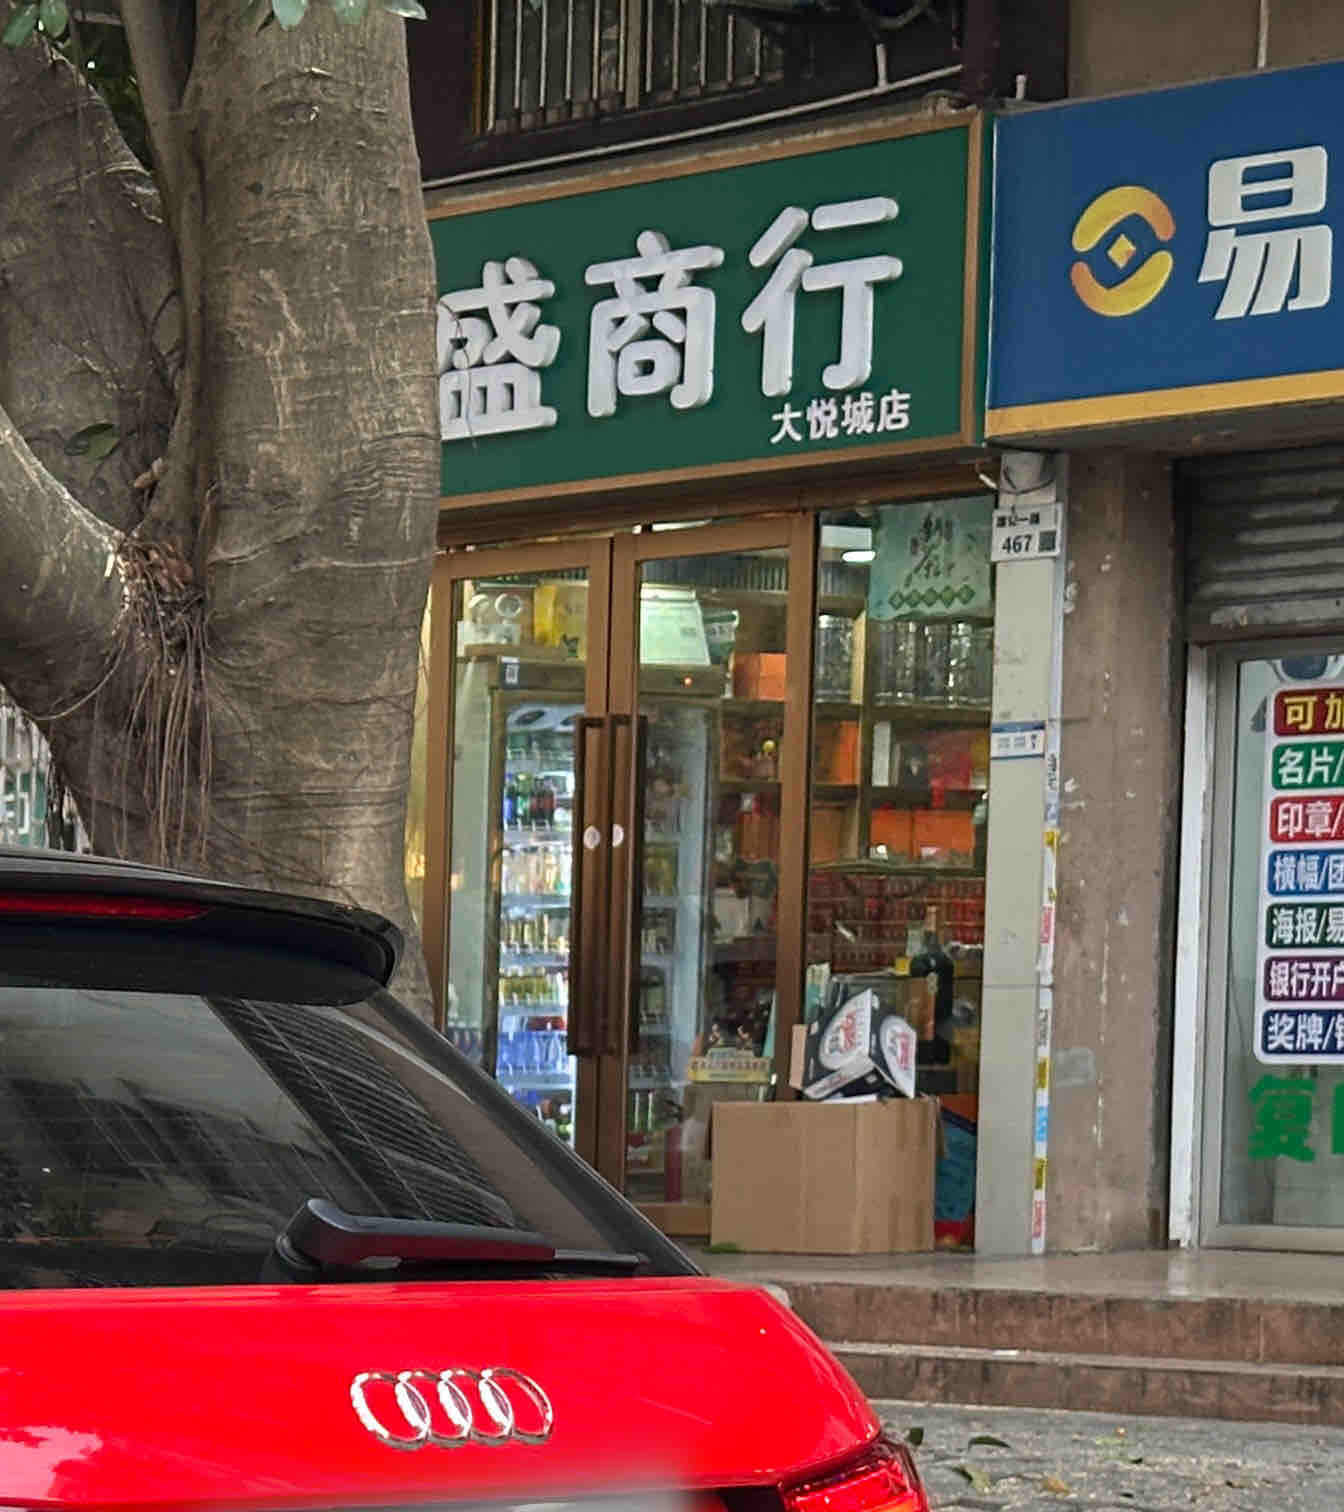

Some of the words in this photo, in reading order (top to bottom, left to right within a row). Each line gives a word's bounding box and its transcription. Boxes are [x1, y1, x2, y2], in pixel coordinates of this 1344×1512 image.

[1198, 145, 1333, 320] 易
[438, 197, 904, 441] 盛商行
[770, 388, 912, 444] 大悦城店
[1001, 534, 1032, 554] 467
[1248, 1074, 1344, 1163] 复
